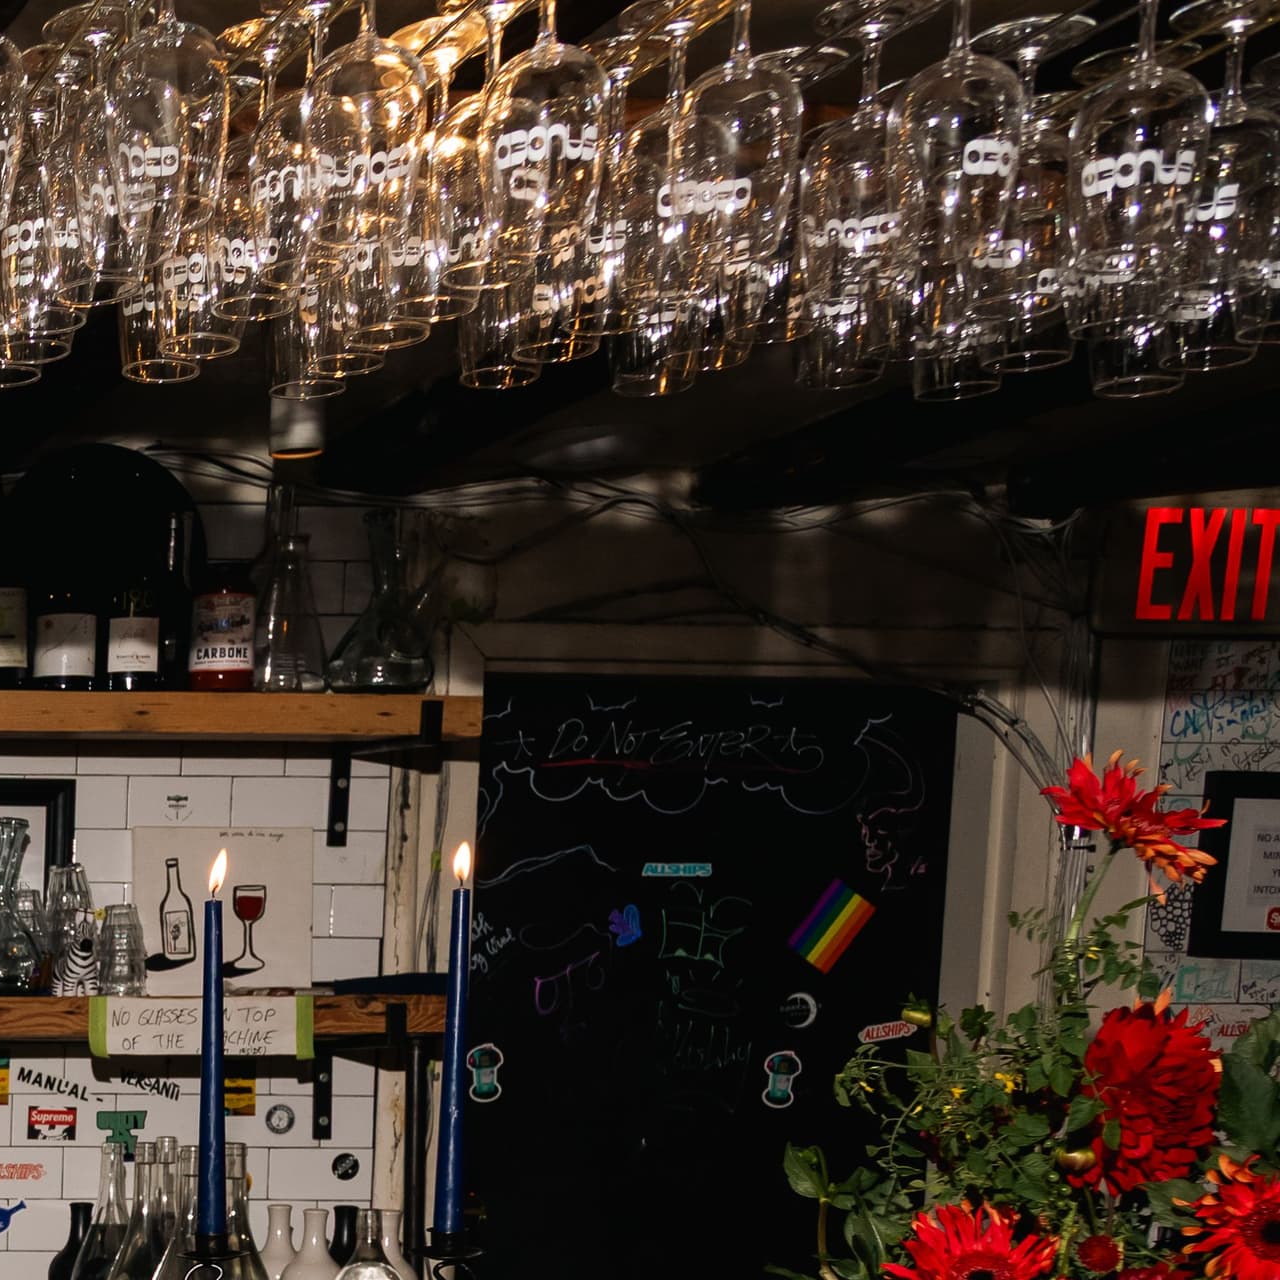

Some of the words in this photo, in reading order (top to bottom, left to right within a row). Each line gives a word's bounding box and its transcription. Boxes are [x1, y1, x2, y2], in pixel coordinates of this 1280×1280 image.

[1134, 508, 1280, 622] EXIT
[196, 647, 248, 660] CARBONE
[642, 862, 712, 877] ALLSHIPS
[111, 1008, 130, 1027] NO
[137, 1007, 198, 1026] GLASSES
[237, 1006, 276, 1022] TOP
[121, 1034, 142, 1051] OF
[152, 1033, 185, 1049] THE
[223, 1029, 279, 1045] ACHINE
[862, 1021, 913, 1042] ALLSHIPS
[17, 1066, 89, 1102] MANUAL
